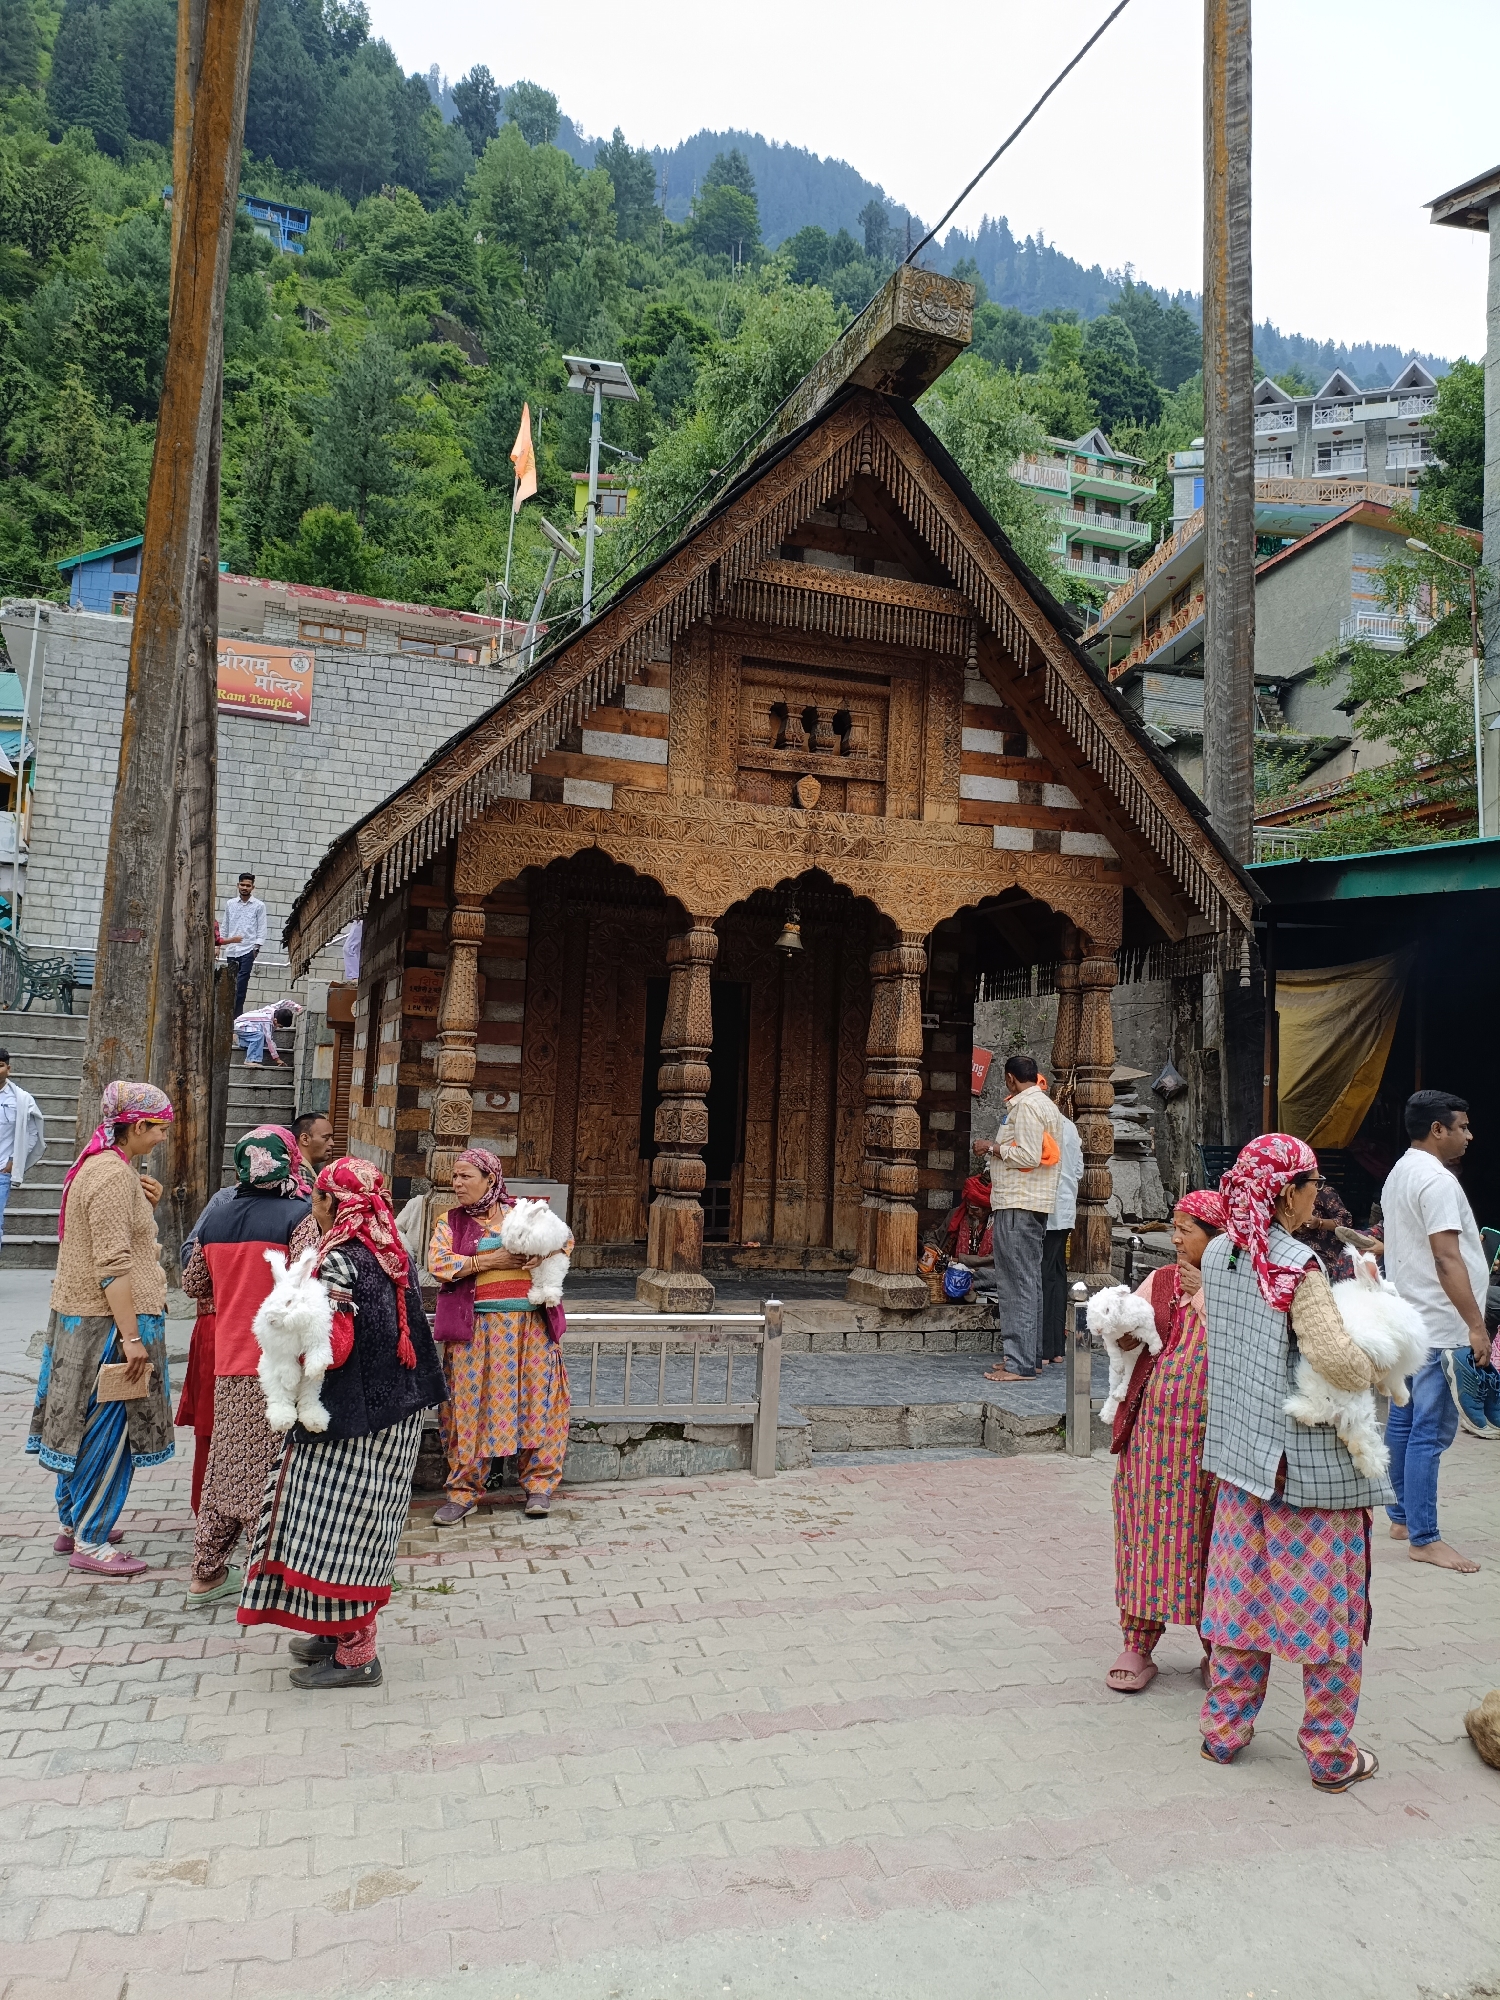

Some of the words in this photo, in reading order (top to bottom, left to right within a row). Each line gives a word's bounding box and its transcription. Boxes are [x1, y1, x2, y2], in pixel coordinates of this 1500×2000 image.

[1034, 467, 1068, 490] DHARMA
[217, 688, 247, 703] Ram
[249, 693, 293, 711] Temple
